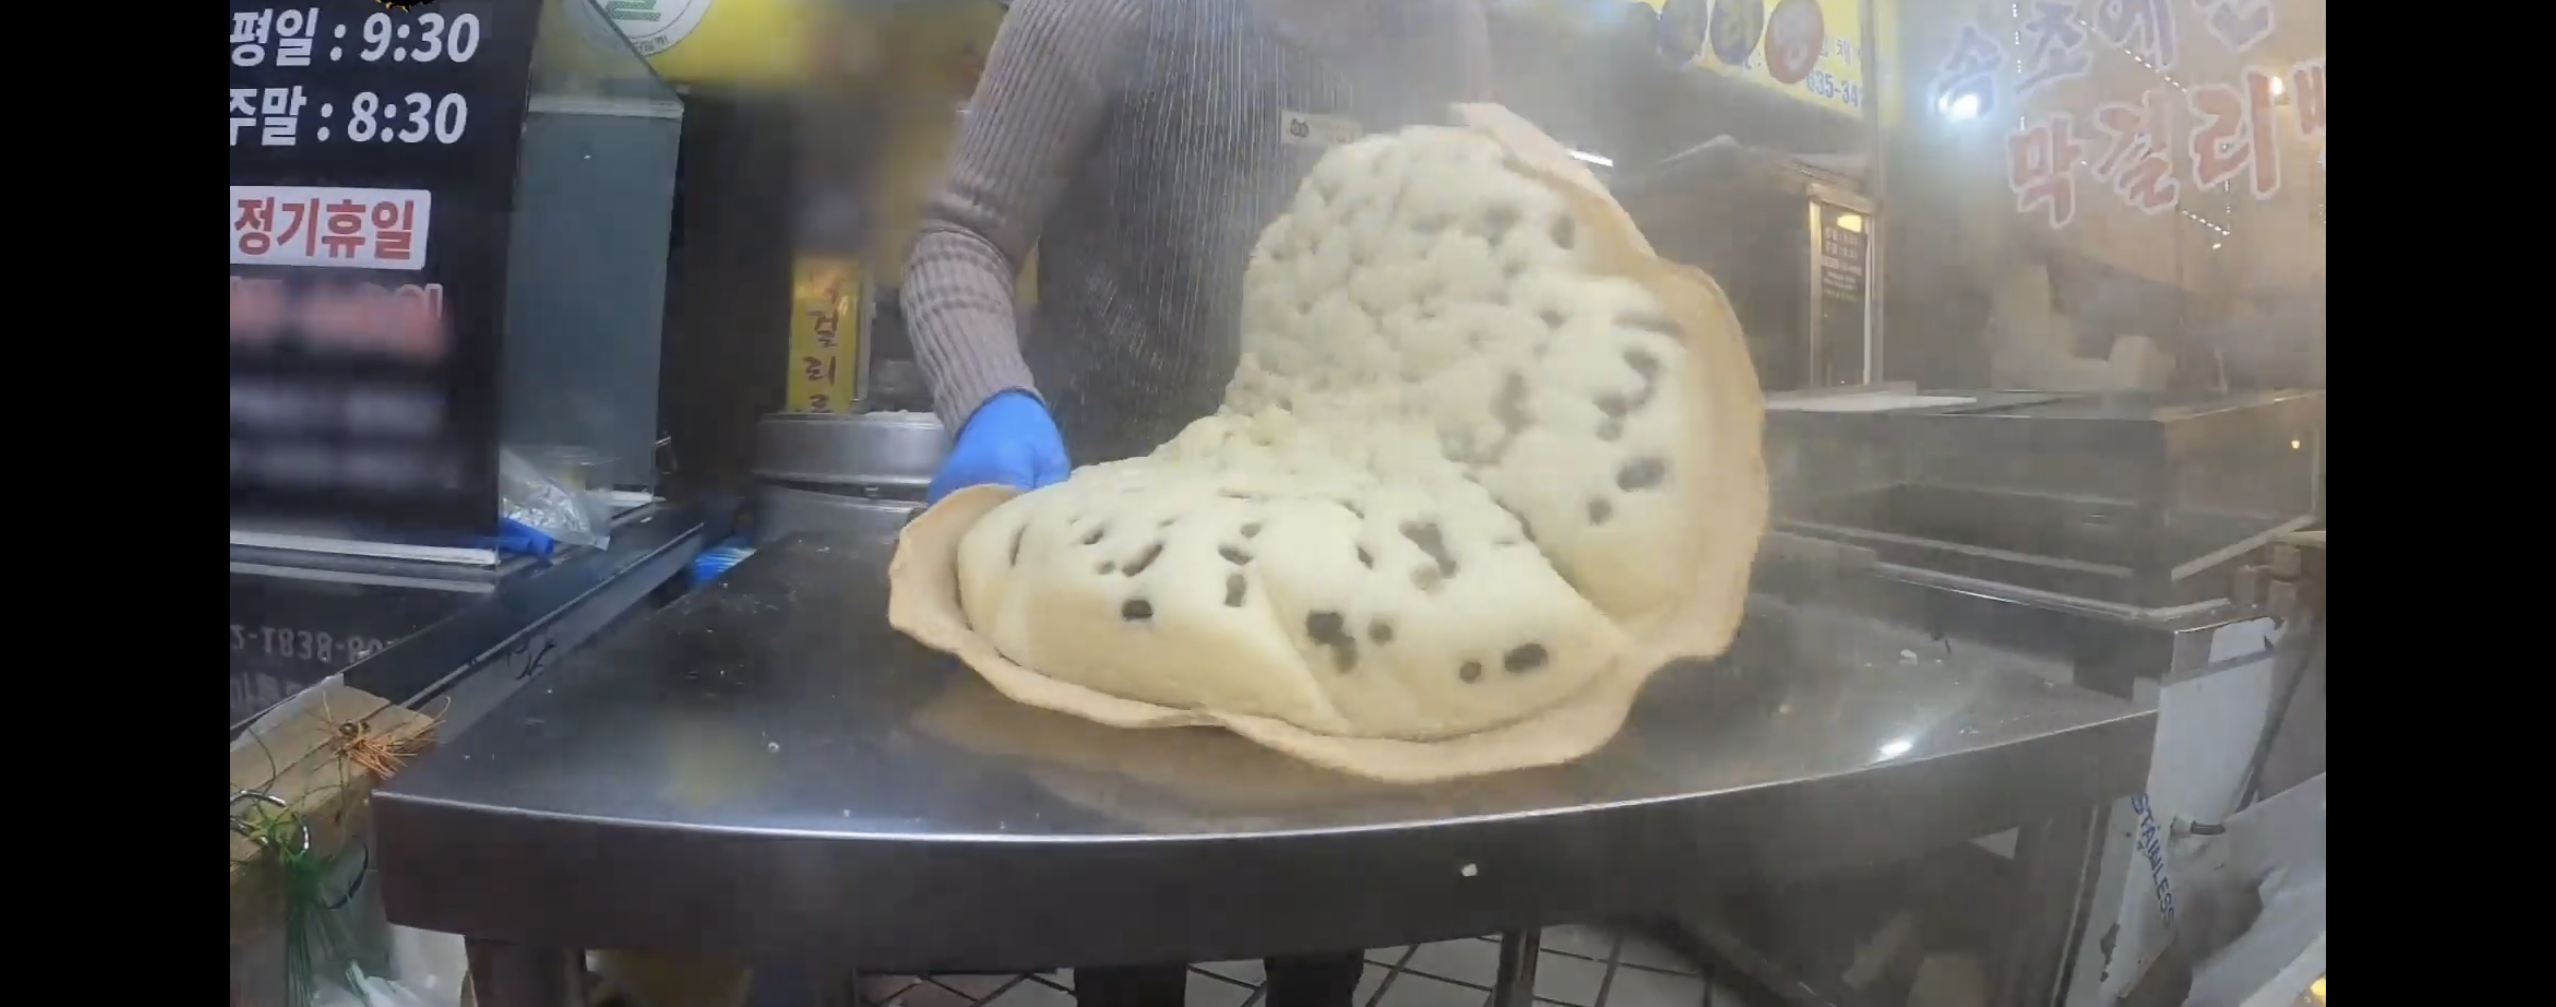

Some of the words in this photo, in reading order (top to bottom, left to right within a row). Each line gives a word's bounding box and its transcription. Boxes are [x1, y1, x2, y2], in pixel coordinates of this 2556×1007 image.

[230, 8, 319, 66] 평일
[360, 12, 480, 63] 9:30
[347, 92, 468, 144] 8:30
[234, 197, 415, 260] 정기휴일
